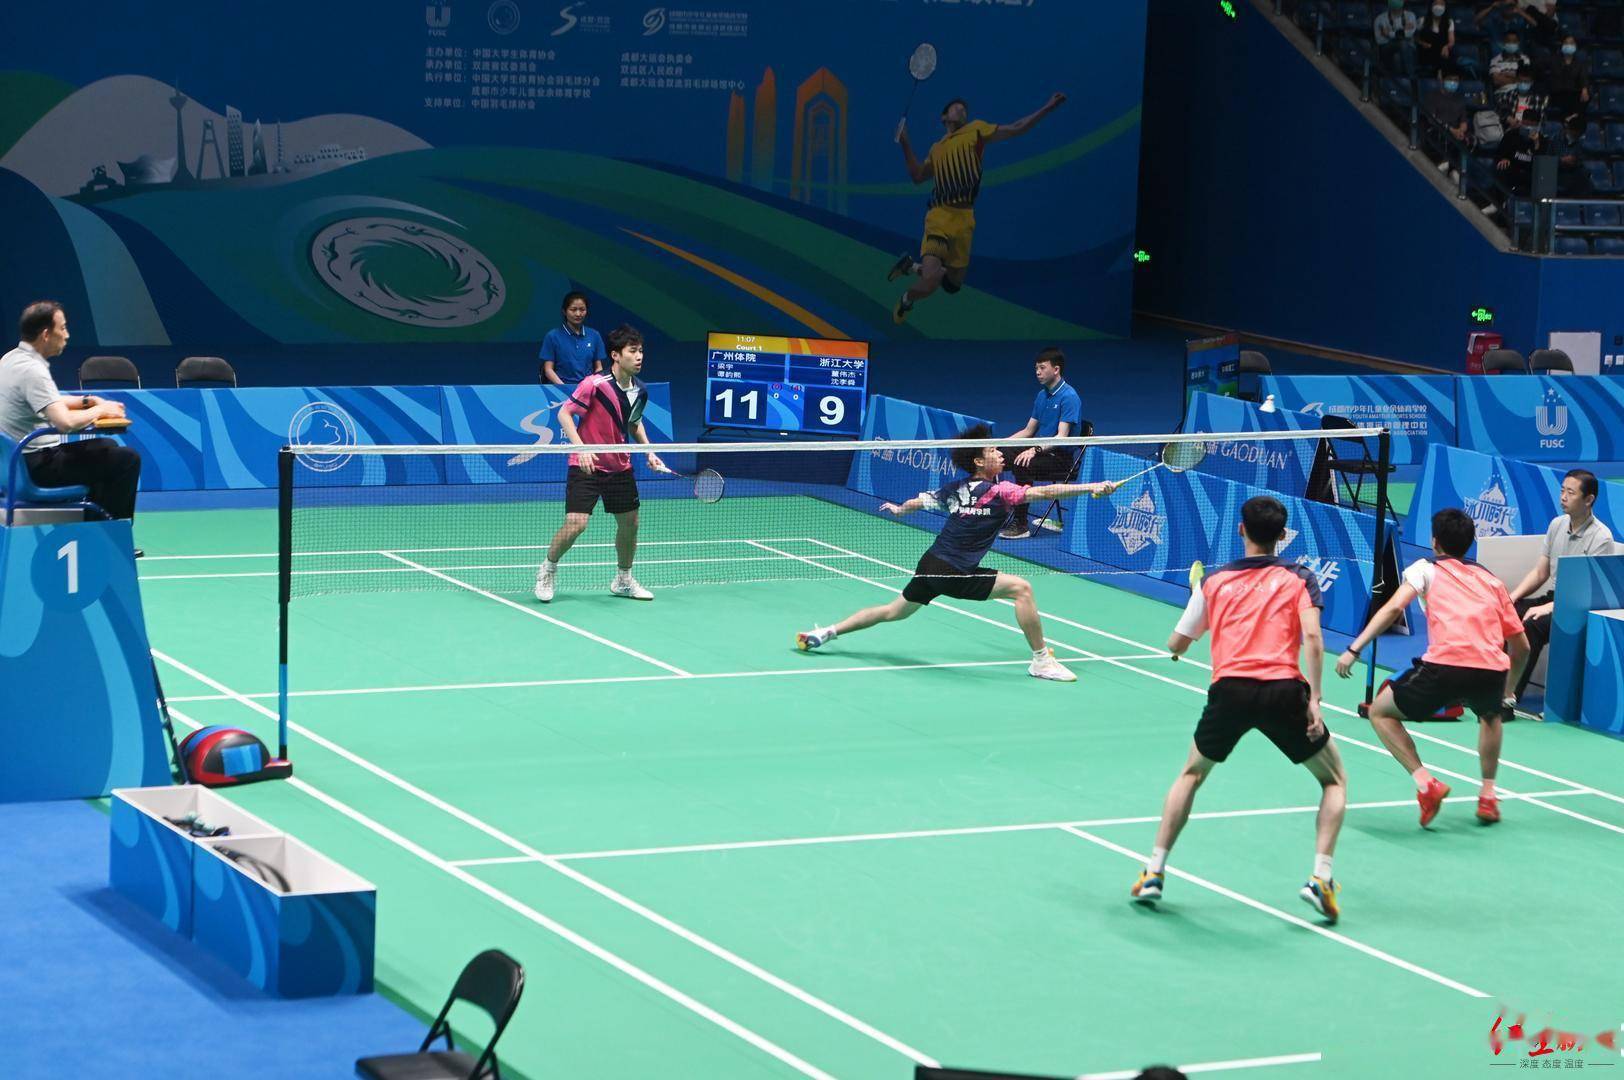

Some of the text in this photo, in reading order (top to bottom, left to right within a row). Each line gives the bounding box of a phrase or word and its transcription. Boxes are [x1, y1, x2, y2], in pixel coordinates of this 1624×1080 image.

[473, 48, 556, 61] 中国大学生体育协会
[472, 73, 601, 87] 中国大学生体育协会羽毛球分会
[471, 98, 536, 110] 中国羽毛球协会
[711, 351, 757, 362] 广州体院
[819, 357, 865, 369] 浙江大学
[715, 388, 758, 420] 11
[819, 395, 845, 426] 9
[1540, 439, 1565, 448] FUSC
[1221, 440, 1288, 470] GAODUAN
[897, 447, 957, 478] GAODUAN
[57, 540, 79, 594] 1
